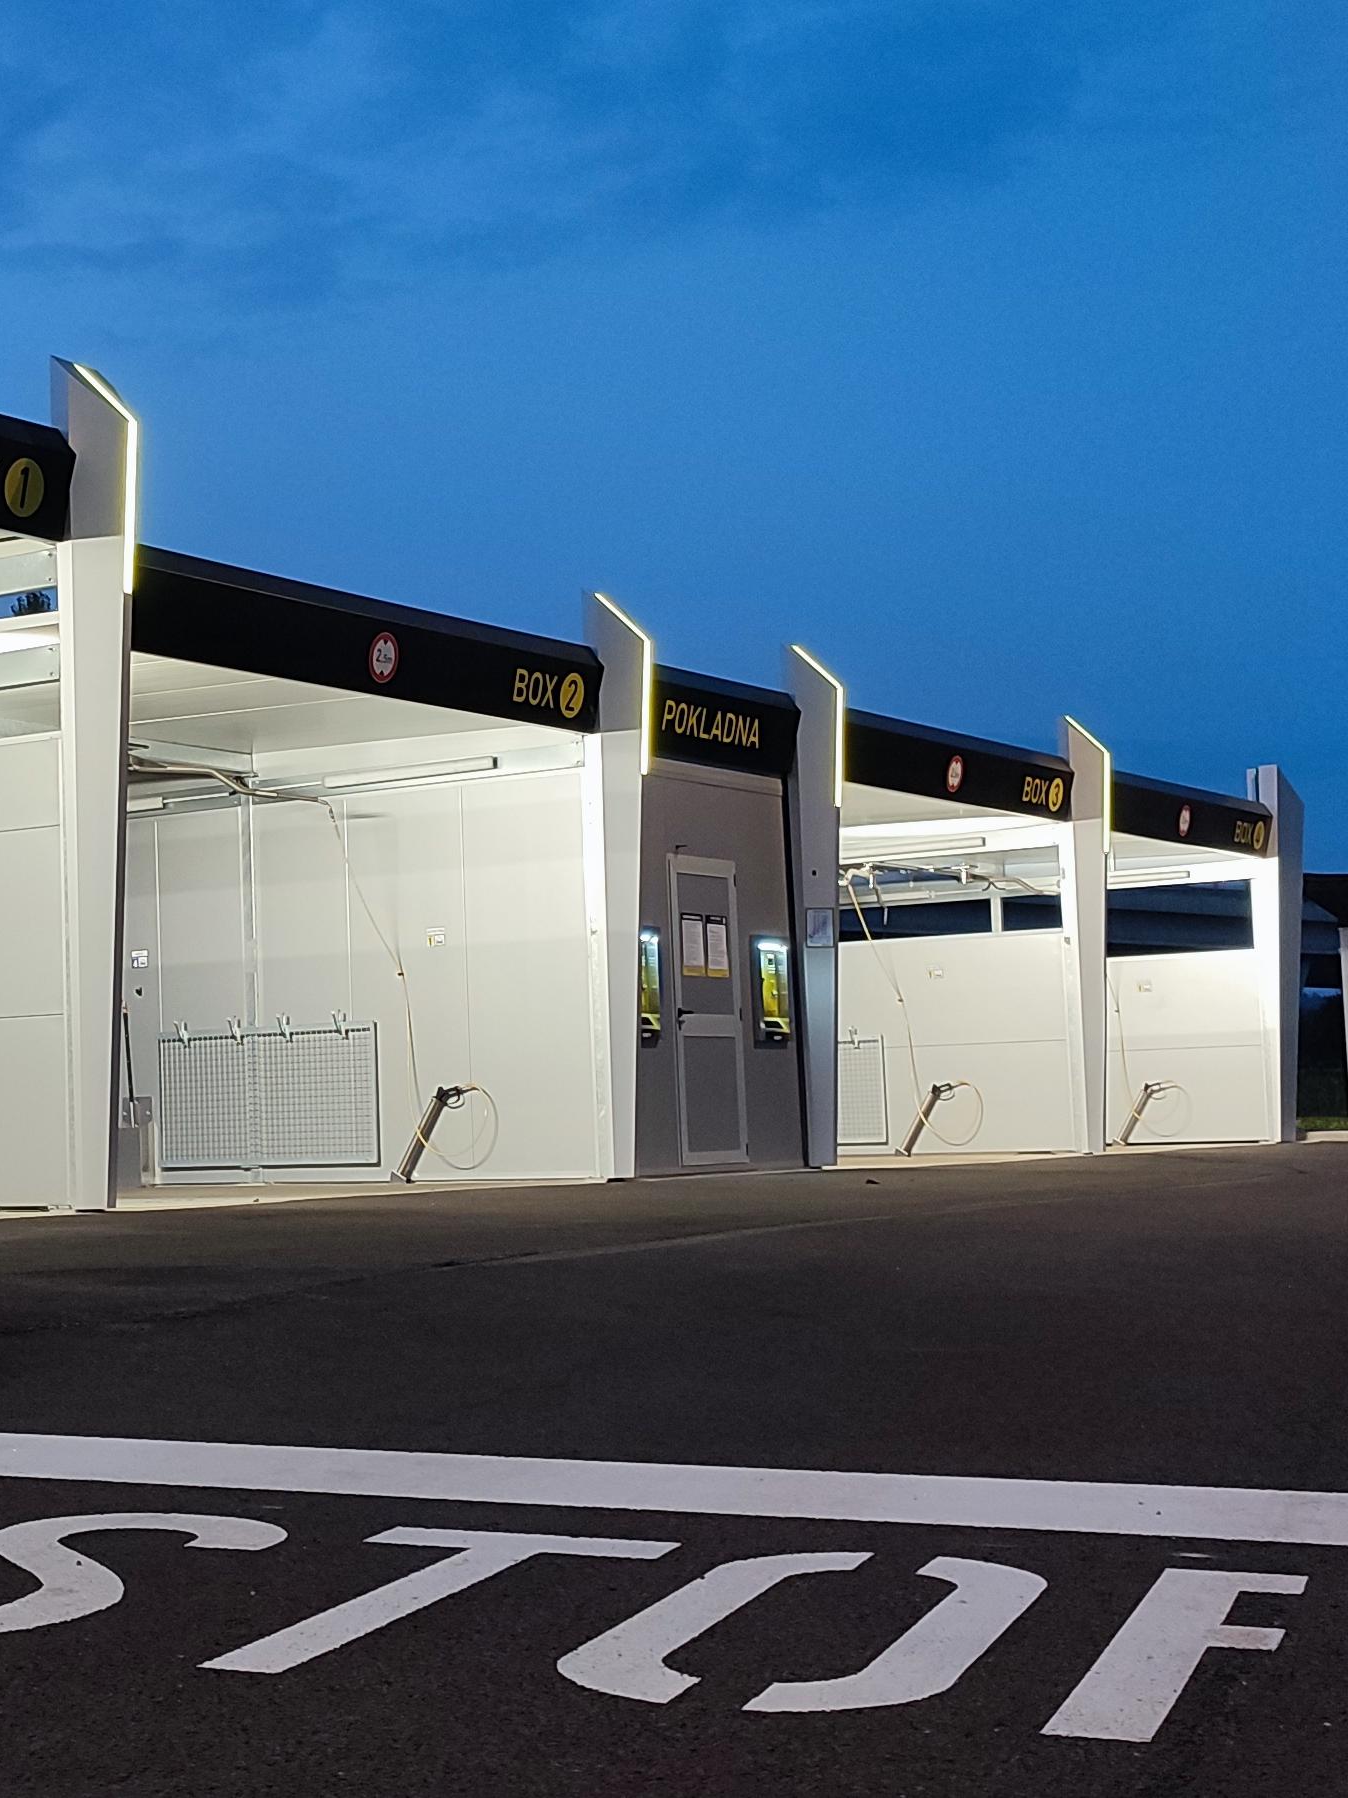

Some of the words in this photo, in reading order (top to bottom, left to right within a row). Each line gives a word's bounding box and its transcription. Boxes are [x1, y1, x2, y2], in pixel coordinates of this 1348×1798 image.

[512, 668, 559, 709] BOX
[564, 679, 580, 713] 2
[662, 698, 760, 750] POKLADNA
[1022, 776, 1049, 805] BOX
[1234, 820, 1254, 845] BOX
